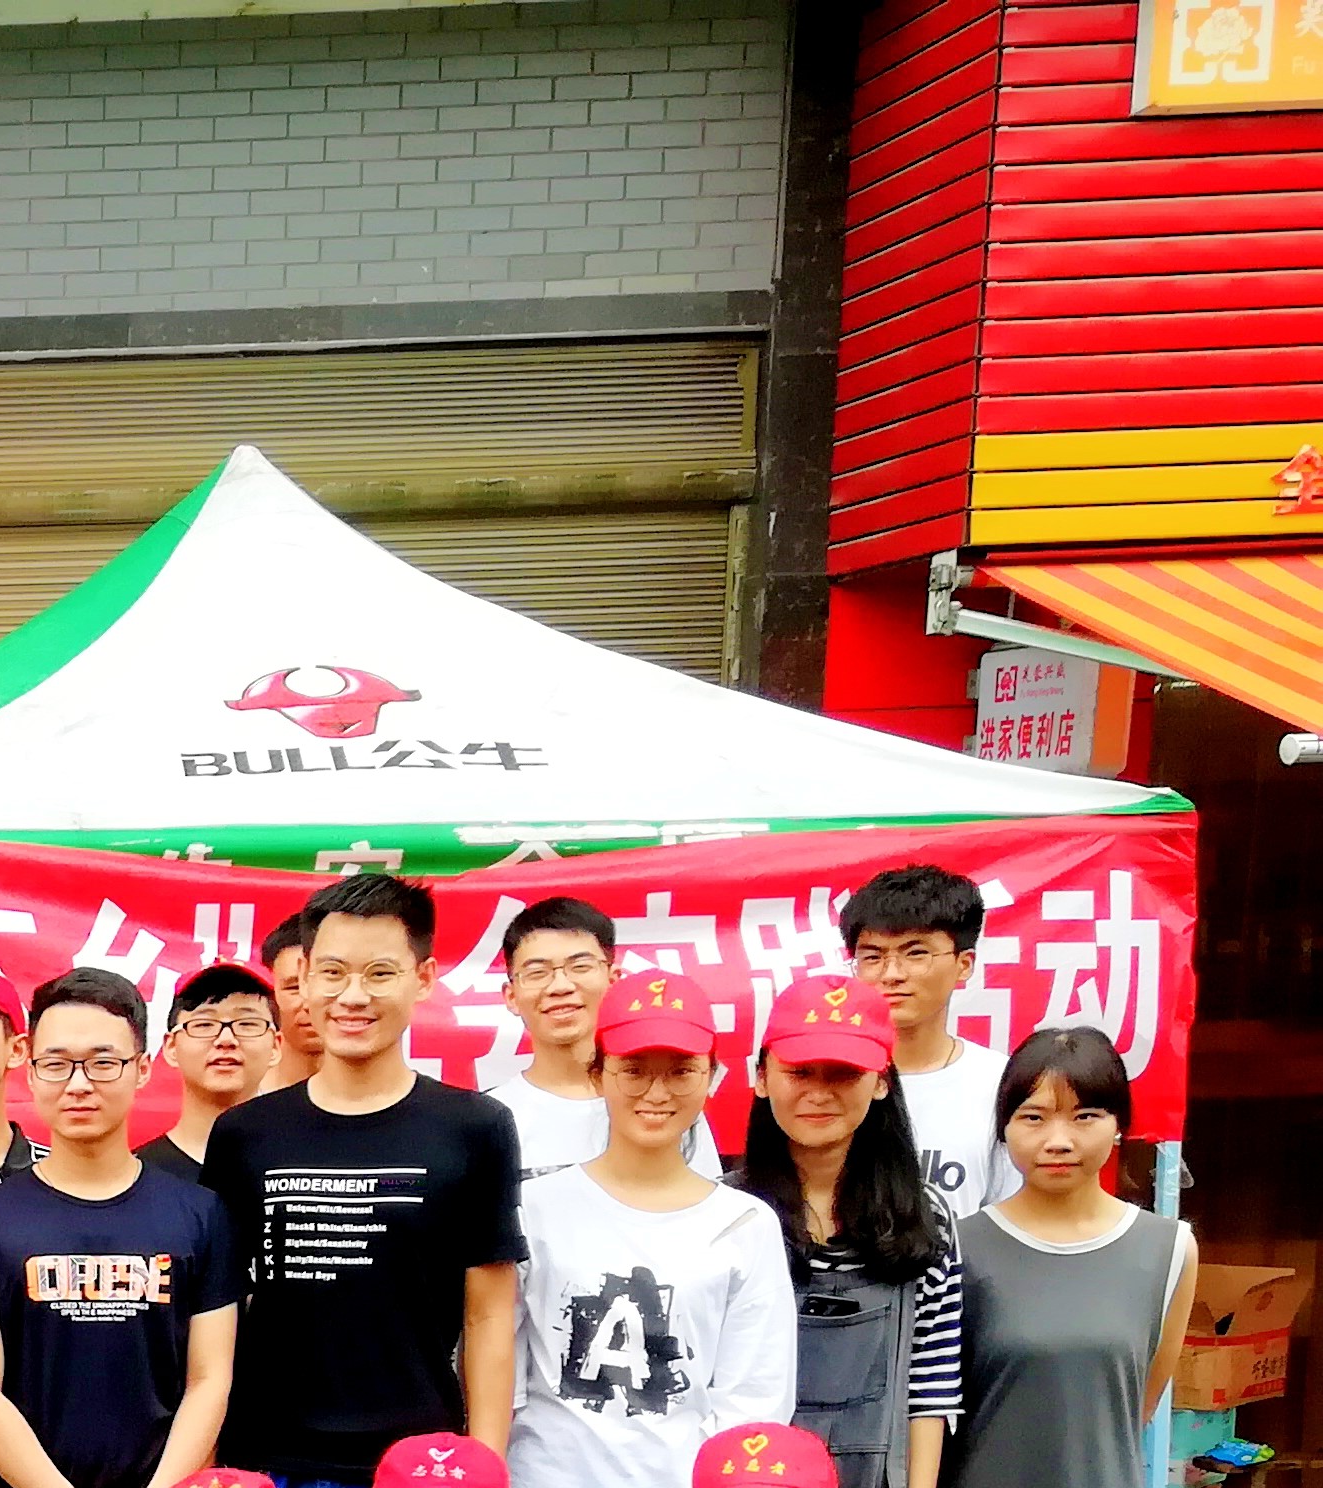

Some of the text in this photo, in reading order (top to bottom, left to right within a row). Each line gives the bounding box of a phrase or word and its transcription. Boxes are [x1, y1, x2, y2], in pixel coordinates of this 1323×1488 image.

[978, 708, 1076, 762] 洪家便利店
[180, 738, 549, 777] BULL 公牛
[263, 1177, 379, 1194] WONDERMENT
[263, 1204, 275, 1216] W
[263, 1222, 273, 1234] Z
[263, 1238, 274, 1250] C
[264, 1254, 275, 1266] K
[266, 1269, 274, 1281] J
[580, 1295, 651, 1389] A
